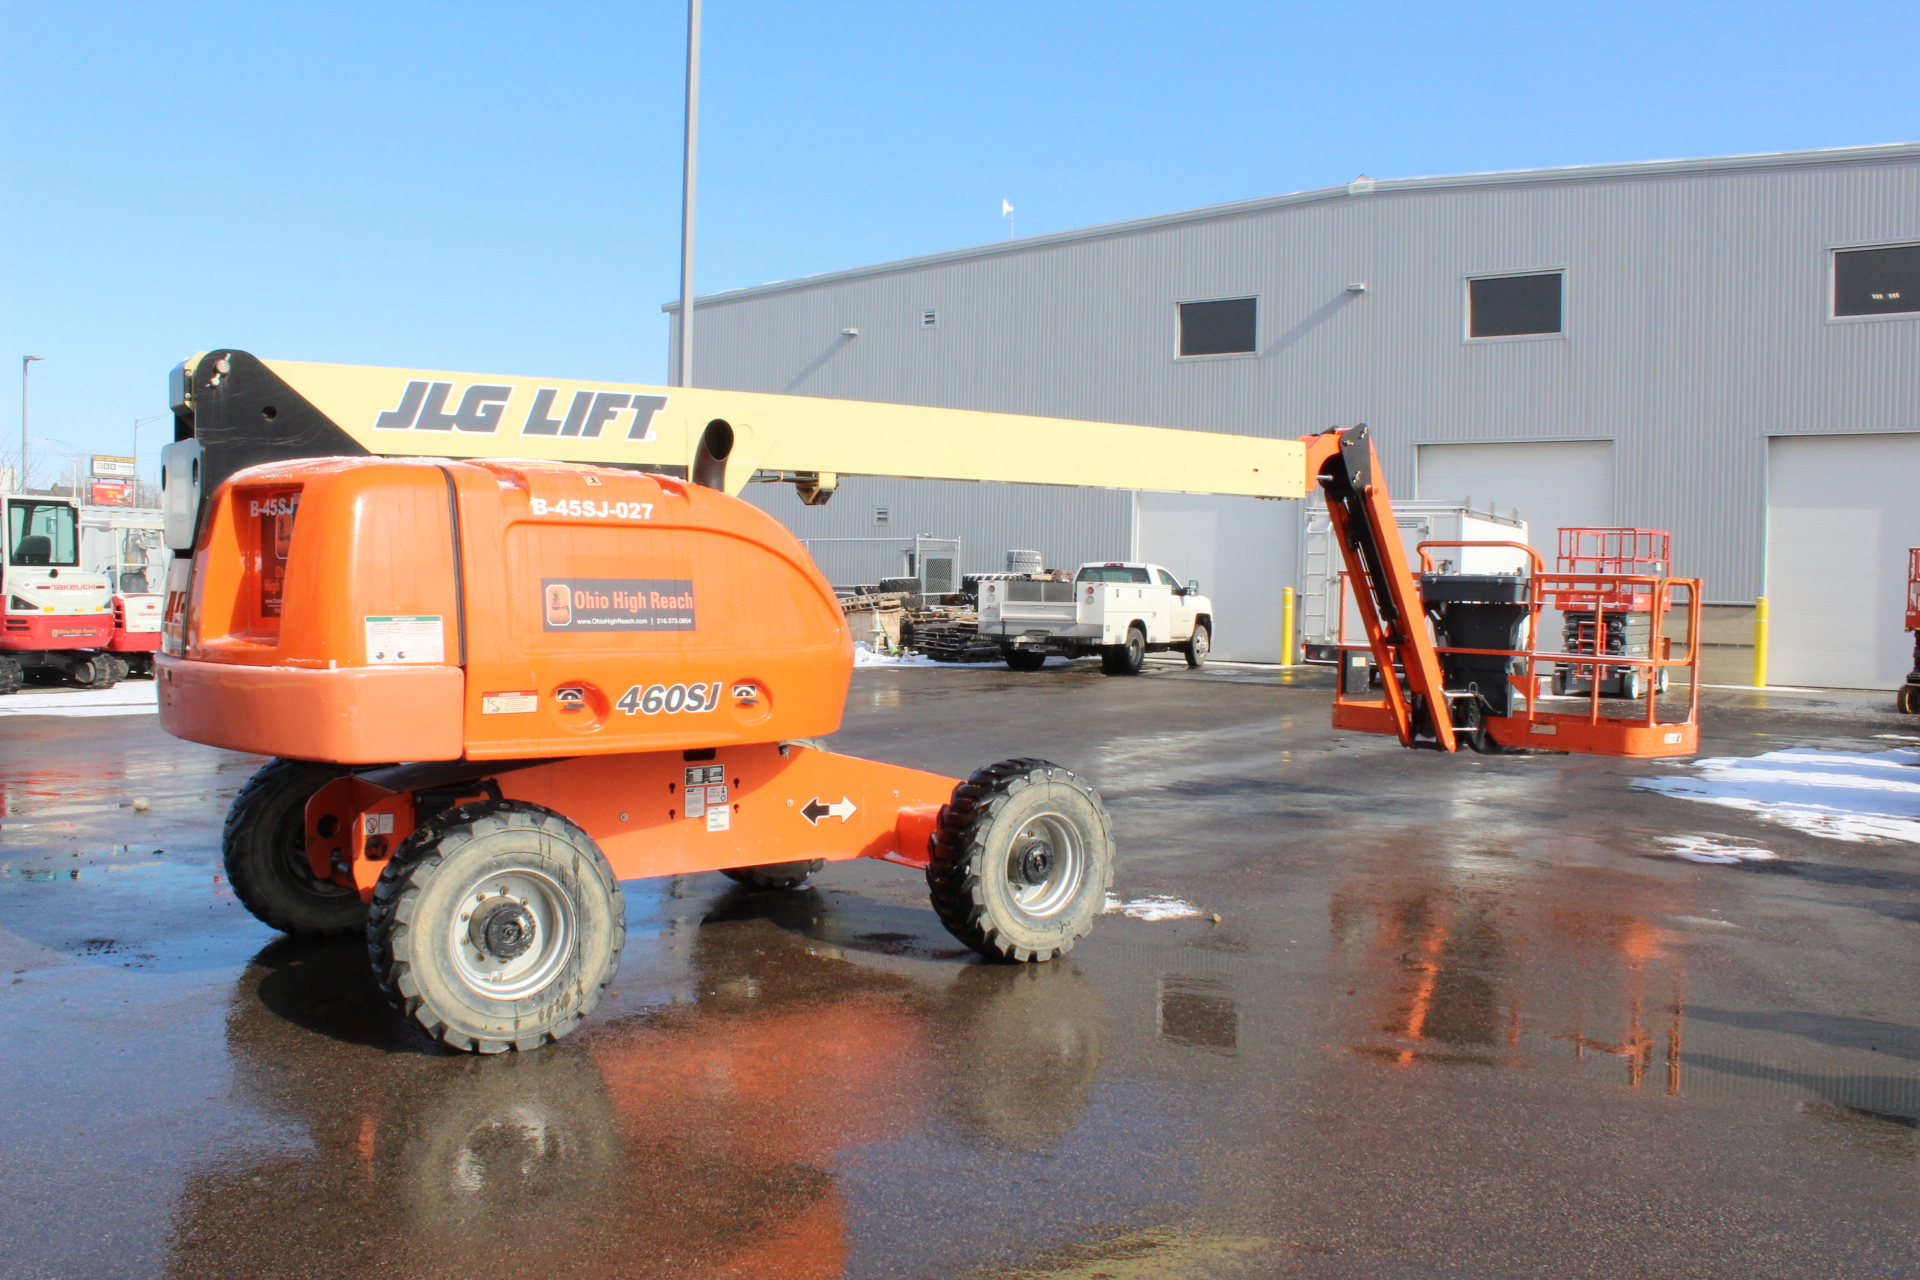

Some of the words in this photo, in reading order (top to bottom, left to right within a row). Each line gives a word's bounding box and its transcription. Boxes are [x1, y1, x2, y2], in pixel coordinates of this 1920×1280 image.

[374, 380, 515, 434] JLG
[519, 387, 671, 441] LIFT
[532, 498, 653, 519] B-45SJ-027
[574, 590, 609, 609] Ohio
[612, 591, 647, 613] High
[651, 591, 694, 609] Reach
[577, 617, 648, 625] www.OhioHighReach.com
[616, 682, 722, 715] 460SJ
